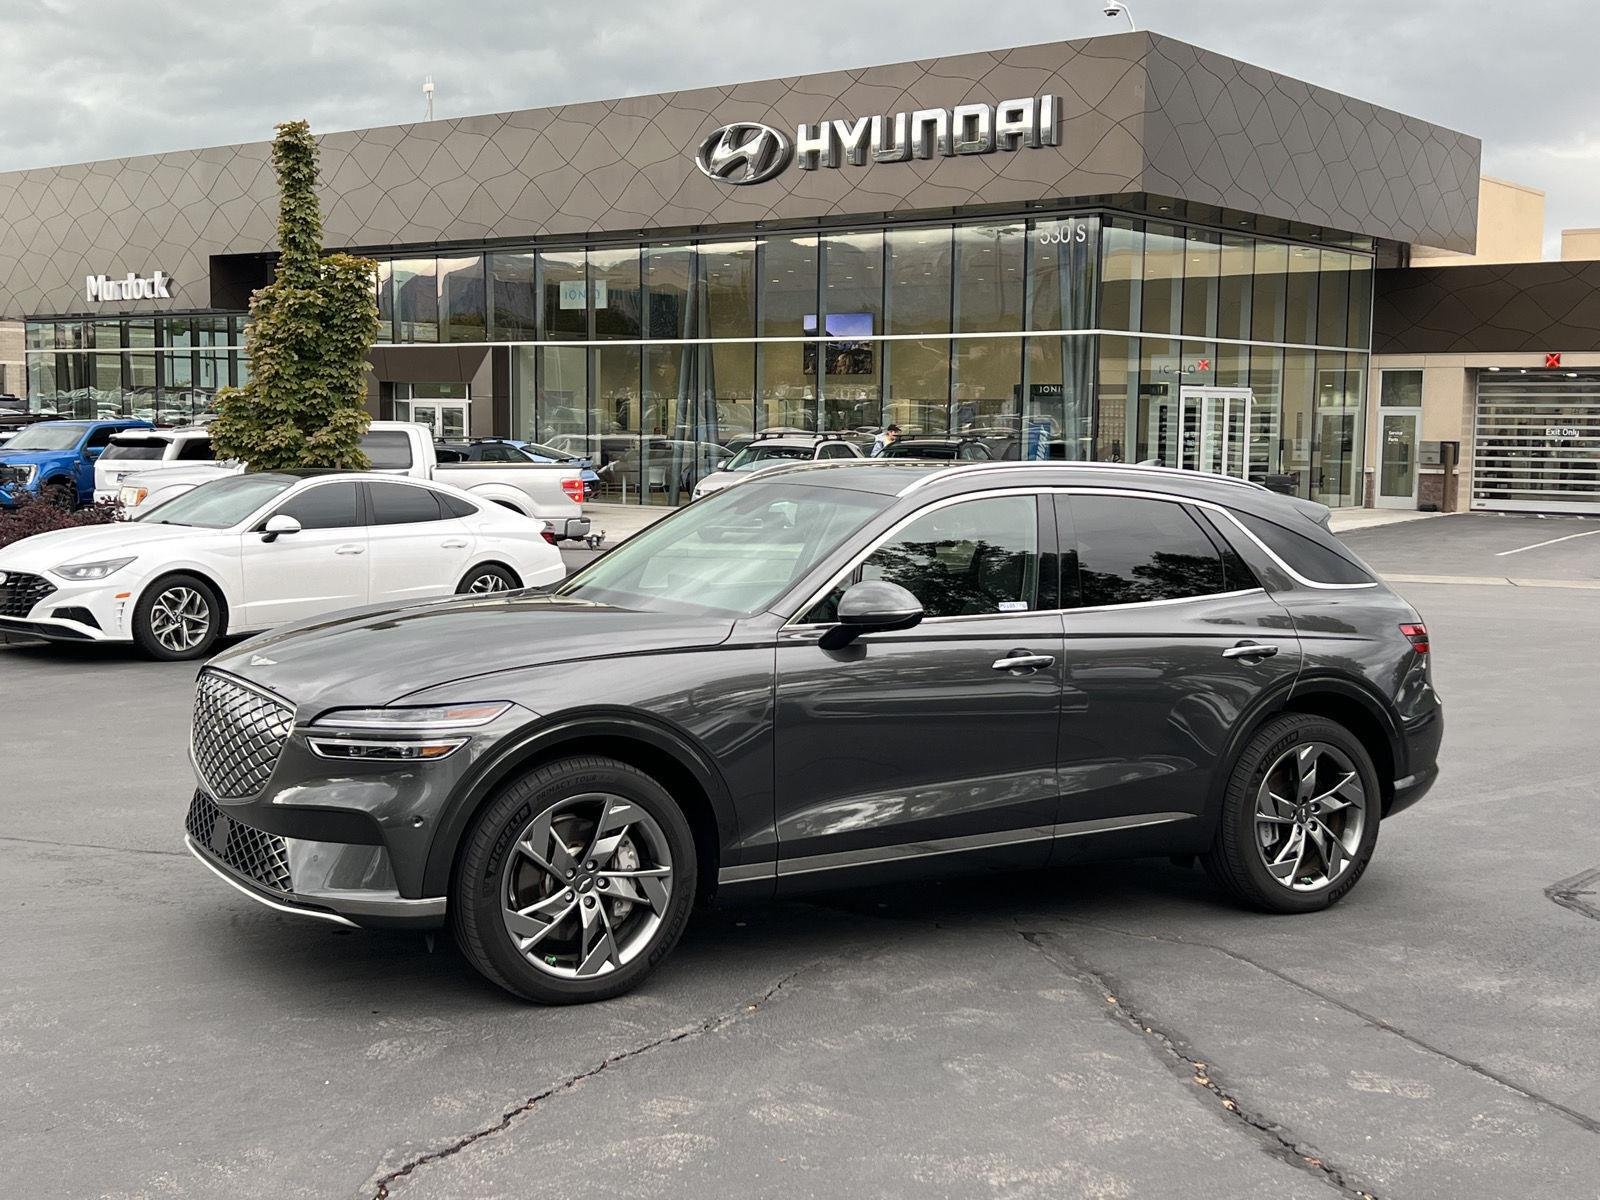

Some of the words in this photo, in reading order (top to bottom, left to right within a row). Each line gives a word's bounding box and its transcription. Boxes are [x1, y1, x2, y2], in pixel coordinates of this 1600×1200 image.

[797, 95, 1061, 170] HYUNDAI
[1075, 223, 1086, 243] S
[86, 270, 170, 302] Murdock
[1039, 385, 1063, 394] IONI
[1545, 428, 1560, 436] Exit
[1562, 428, 1580, 438] Only
[486, 803, 531, 875] MICHELIN
